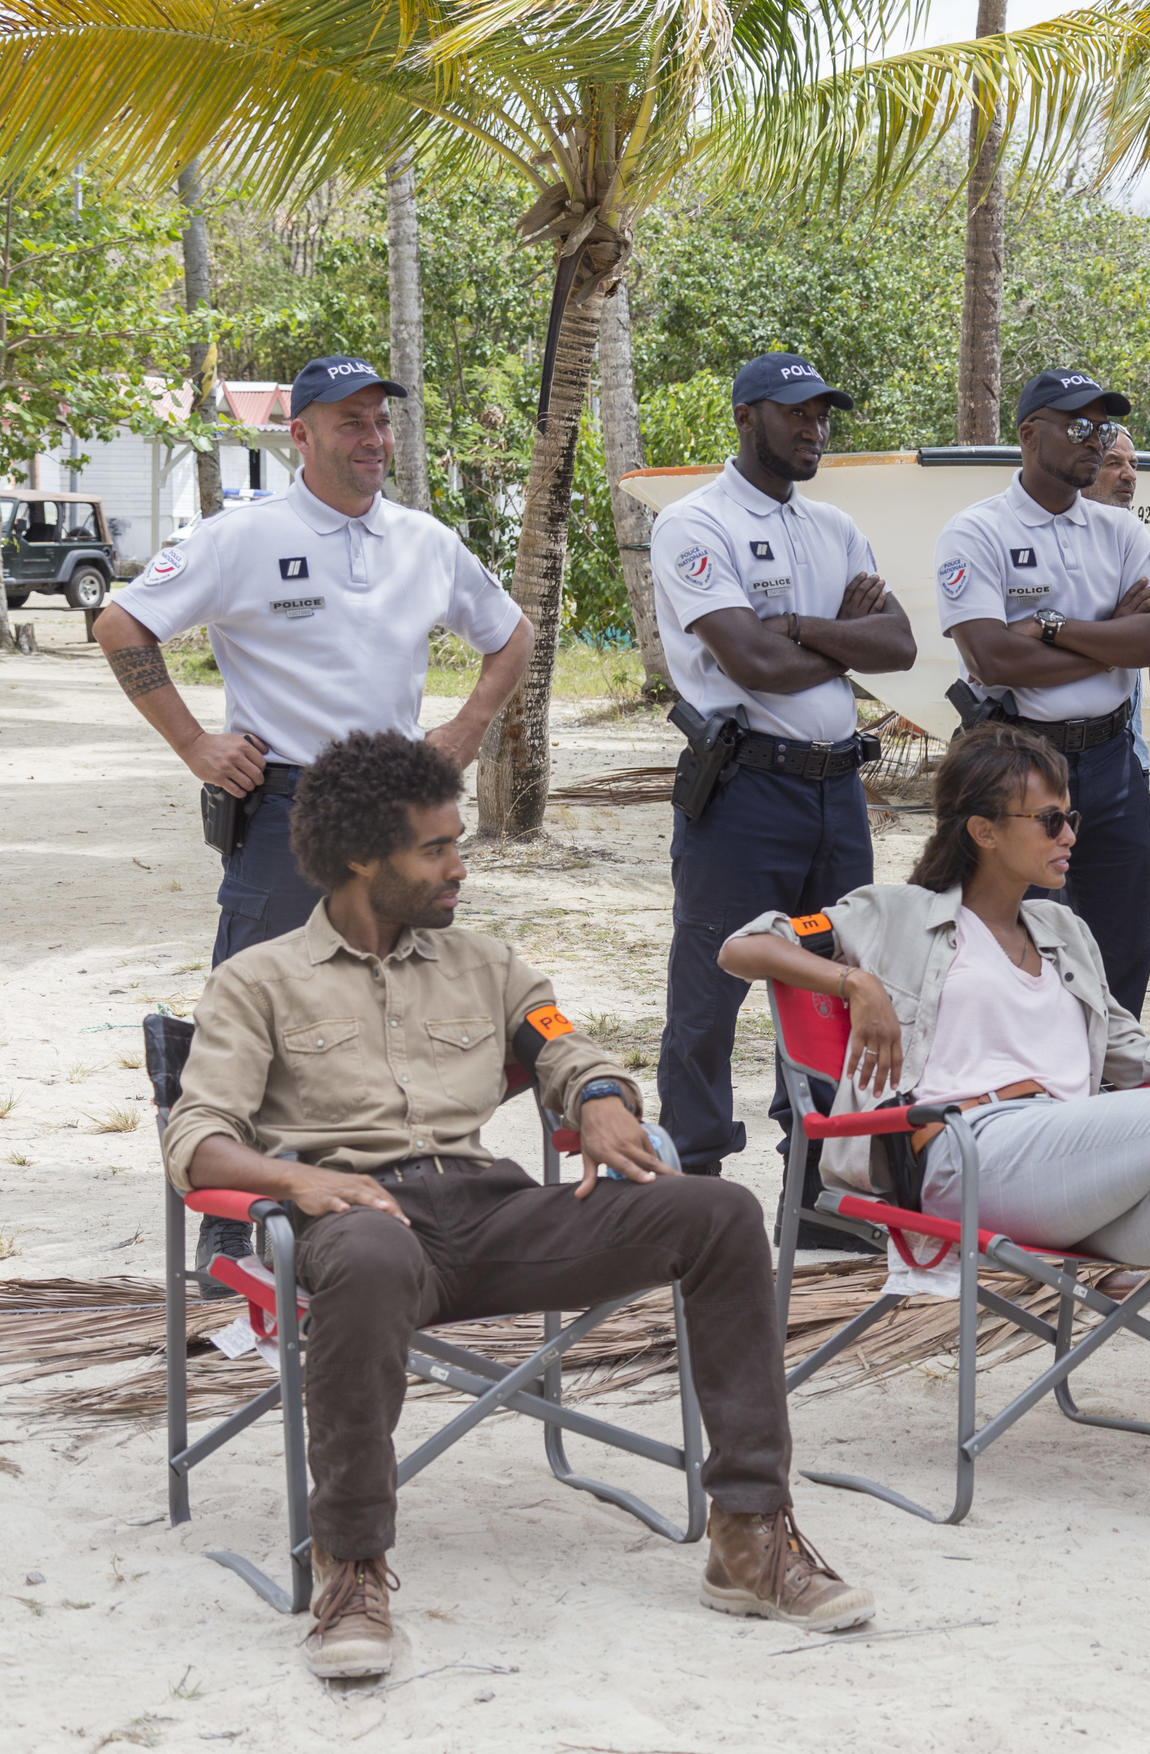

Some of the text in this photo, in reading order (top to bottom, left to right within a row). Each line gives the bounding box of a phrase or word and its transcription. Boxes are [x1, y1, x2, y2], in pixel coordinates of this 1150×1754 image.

[753, 578, 791, 590] POLICE
[1008, 586, 1050, 595] POLICE
[273, 599, 322, 609] POLICE
